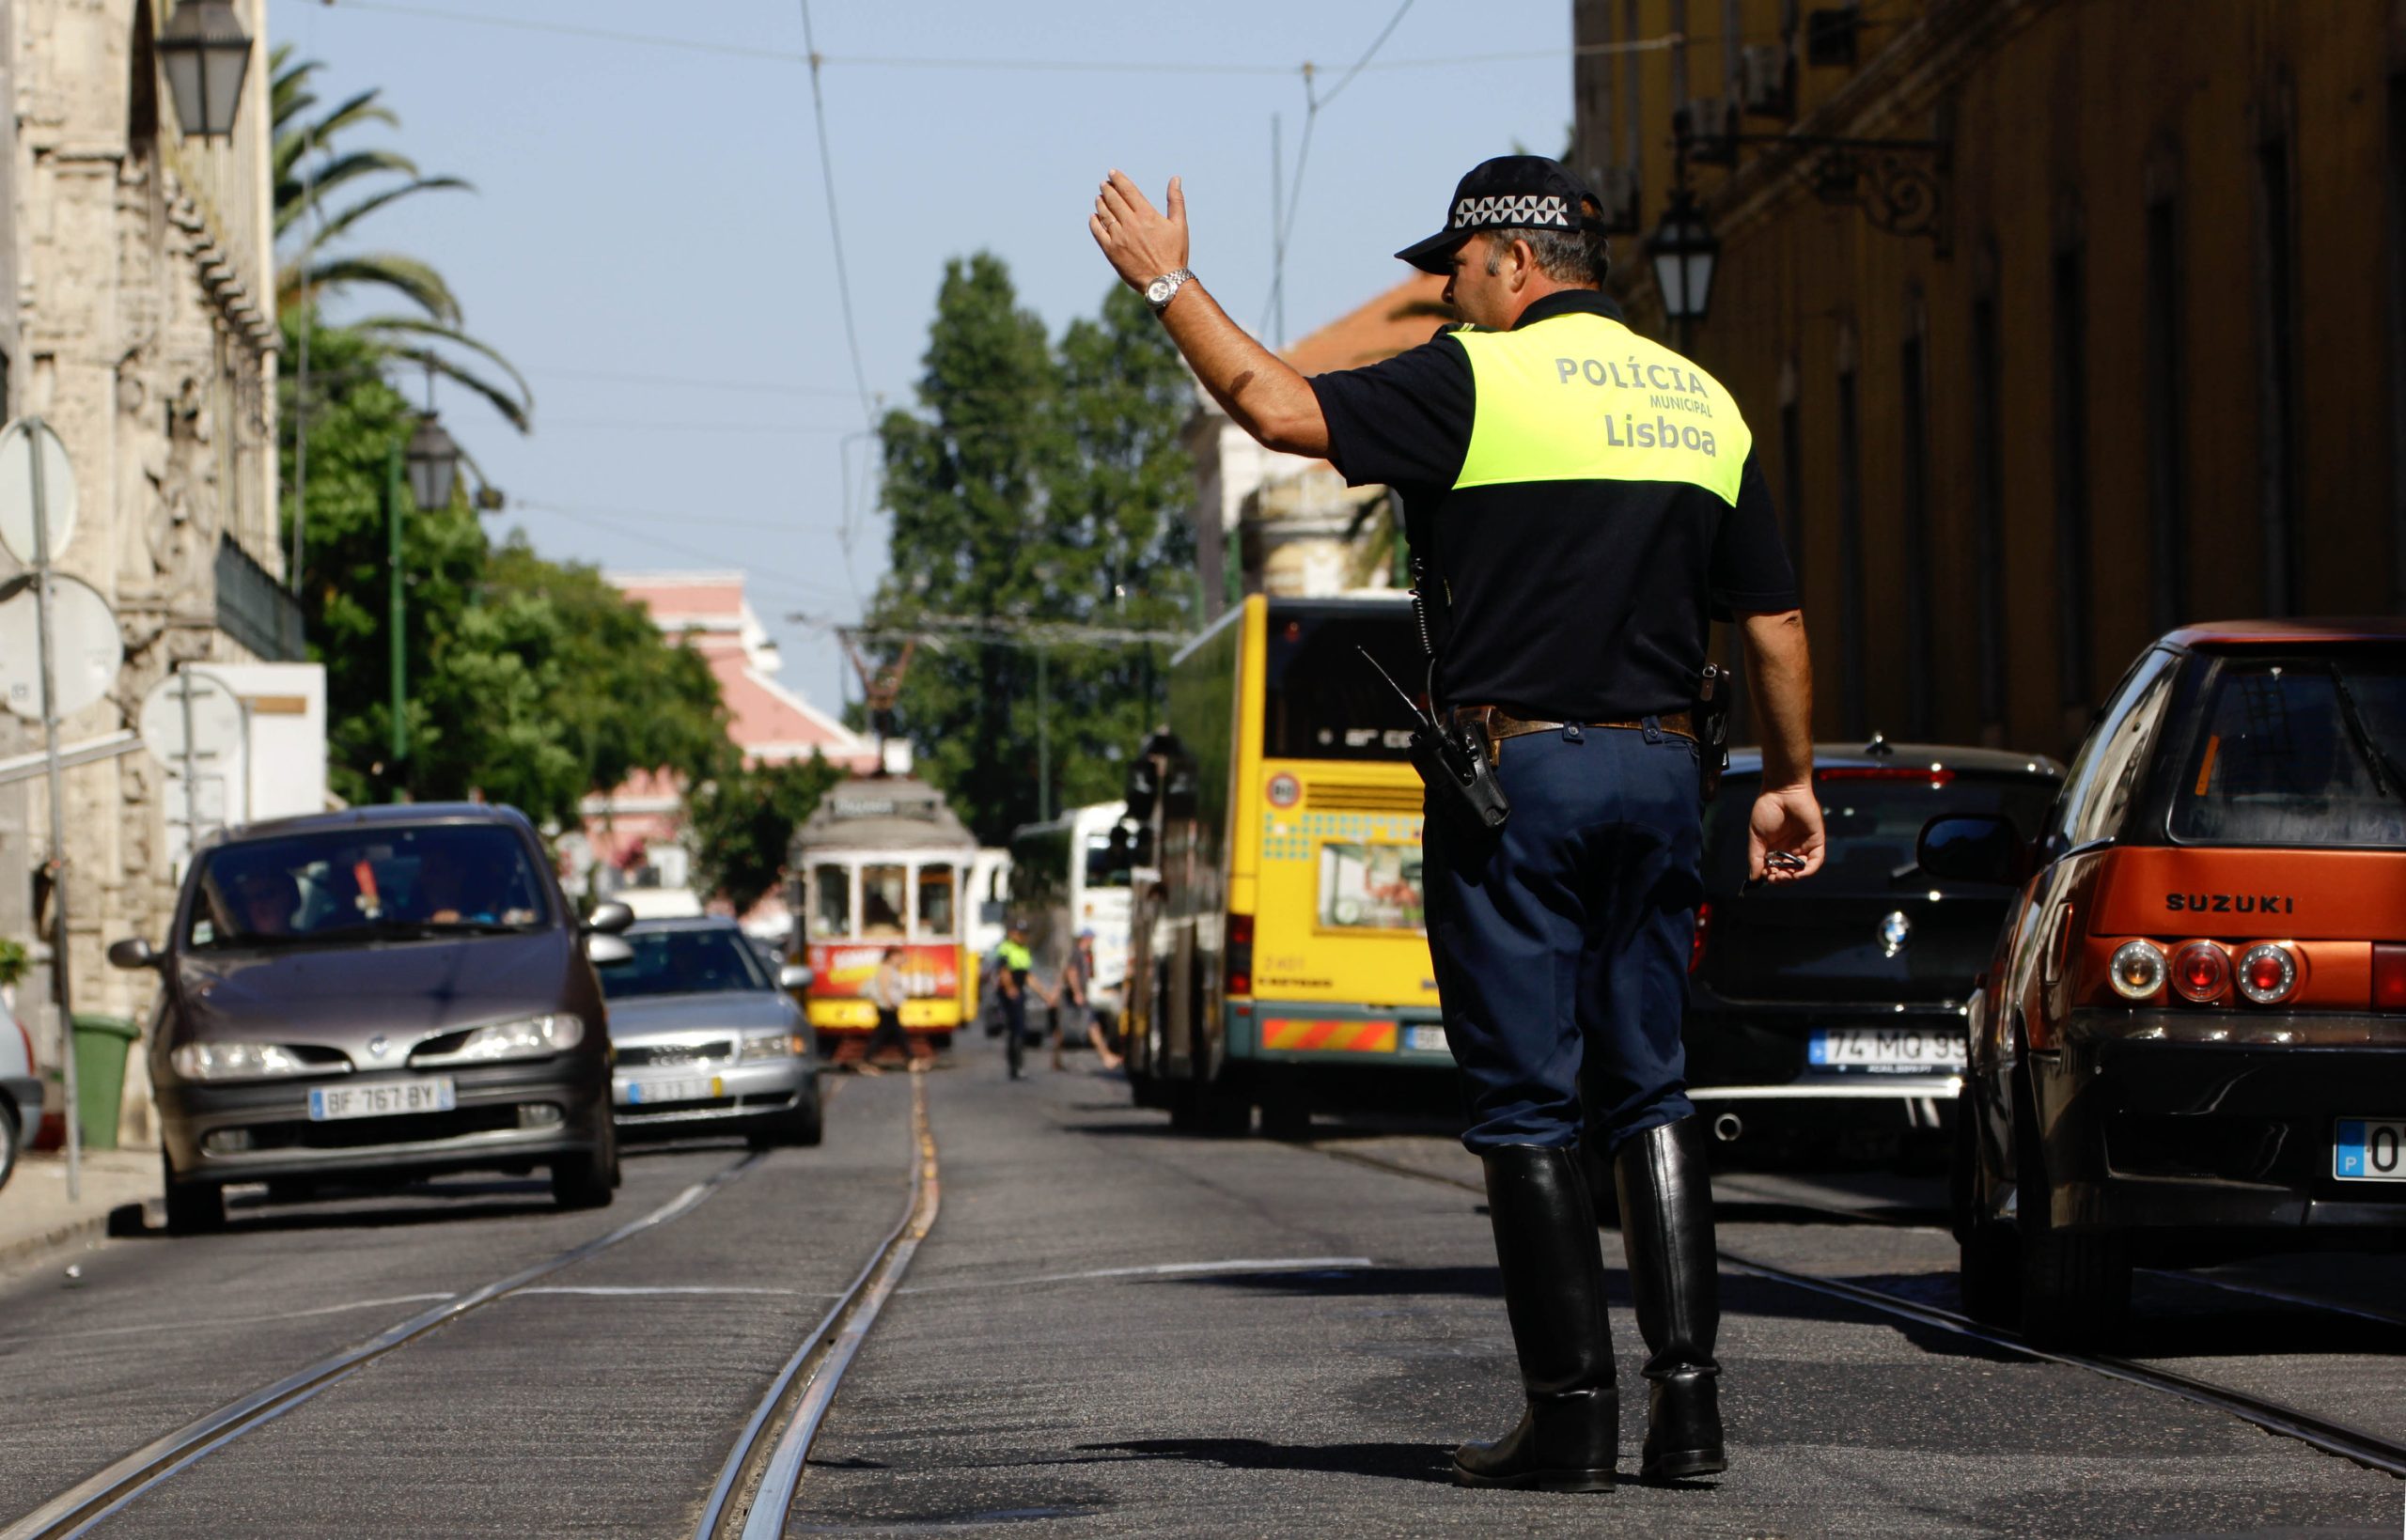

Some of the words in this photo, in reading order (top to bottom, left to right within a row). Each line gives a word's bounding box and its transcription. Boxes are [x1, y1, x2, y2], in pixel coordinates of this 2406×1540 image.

[1555, 355, 1709, 398] POLÍCIA
[1650, 395, 1712, 418] MUNICIPAL
[1604, 413, 1716, 458] Lisboa
[2165, 894, 2293, 914] SUZUKI
[2345, 1156, 2357, 1173] P
